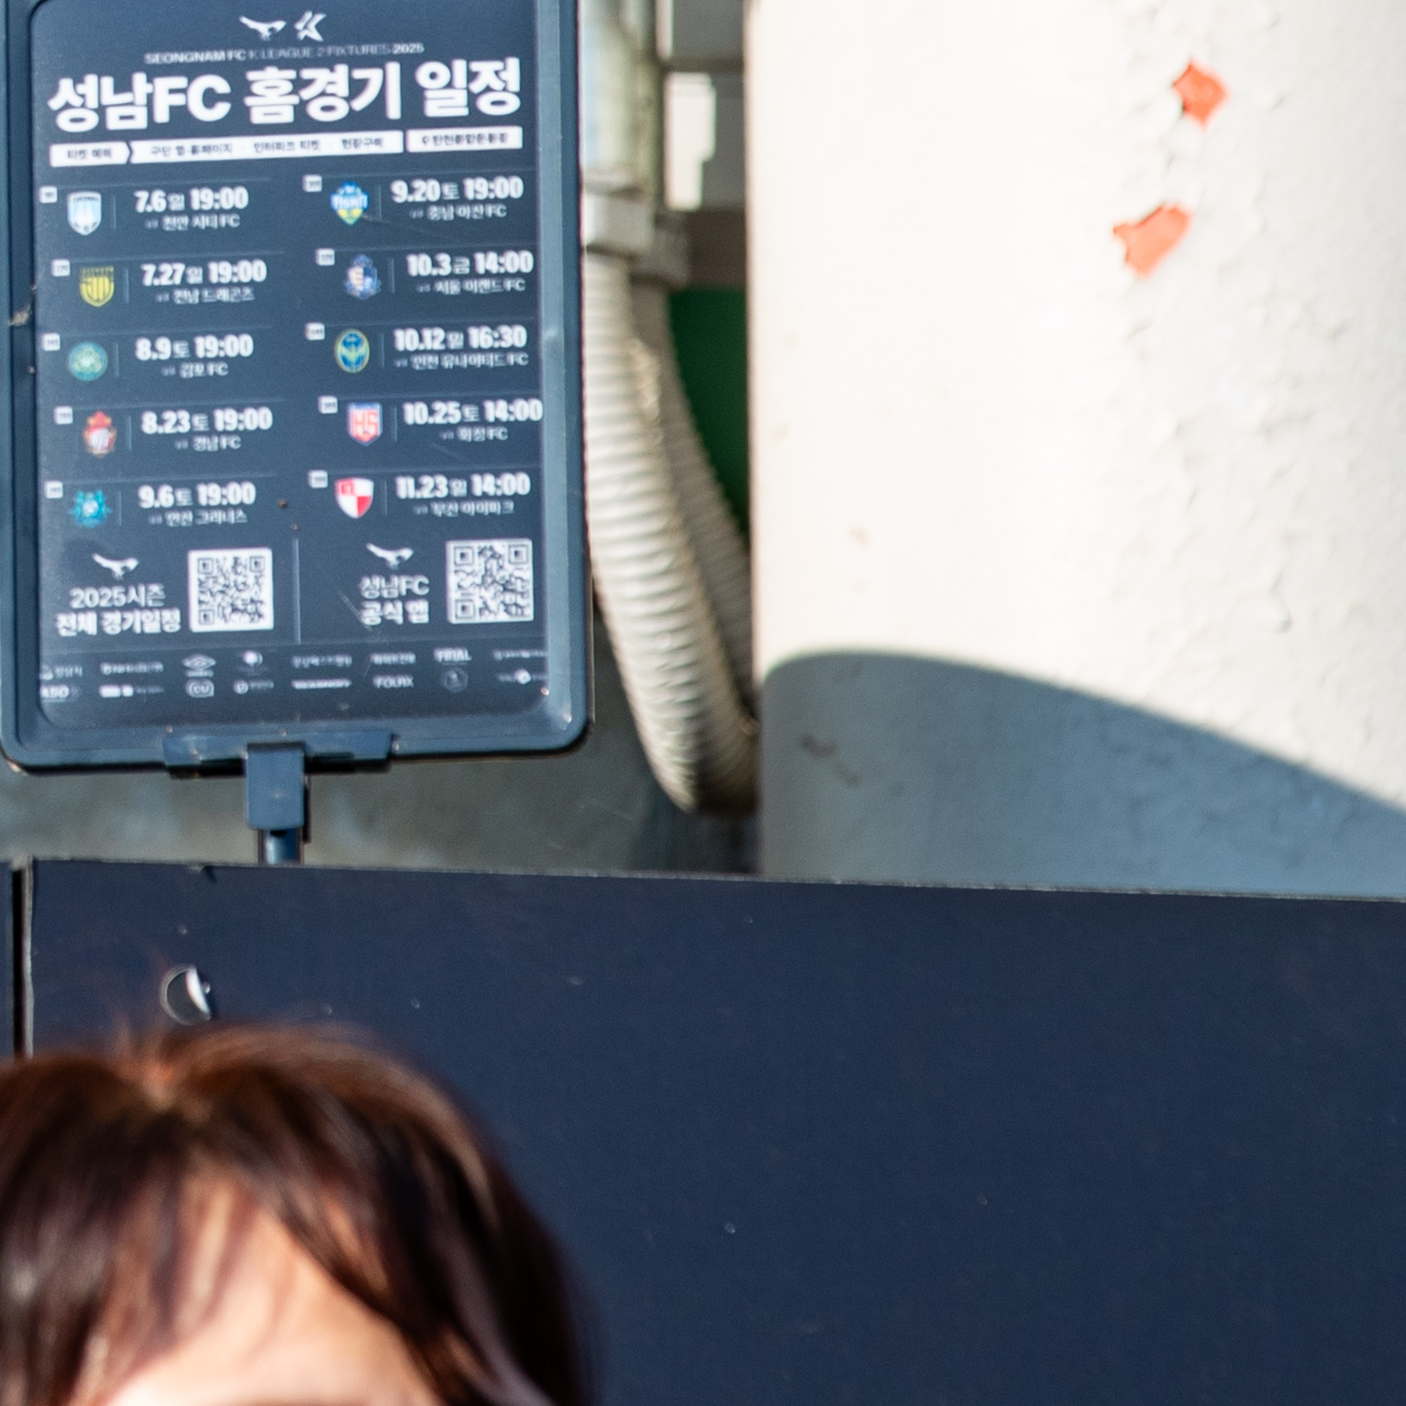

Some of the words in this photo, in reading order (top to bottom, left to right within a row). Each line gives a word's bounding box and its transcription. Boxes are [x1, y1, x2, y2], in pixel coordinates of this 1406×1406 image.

[144, 51, 226, 64] SEONGNAM
[227, 50, 246, 61] FC
[392, 43, 424, 54] 2025
[47, 71, 232, 132] 성남FC
[243, 61, 401, 124] 홈경기
[415, 56, 521, 116] 일정
[190, 186, 248, 211] 19:00
[463, 175, 524, 201] 19:00
[219, 213, 240, 228] FC
[486, 204, 507, 218] FC
[207, 259, 267, 283] 19:00
[474, 250, 534, 275] 14:00
[504, 278, 526, 292] FC
[193, 333, 254, 358] 19:00
[468, 324, 527, 349] 16:30
[208, 362, 229, 376] FC
[507, 352, 529, 366] FC
[213, 406, 273, 431] 19:00
[483, 398, 543, 422] 14:00
[220, 435, 241, 449] FC
[487, 426, 508, 440] FC
[197, 481, 256, 506] 19:00
[470, 472, 531, 496] 14:00
[70, 583, 165, 608] 2025시즌
[360, 574, 429, 599] 성남FC
[56, 610, 97, 636] 전체
[101, 608, 180, 634] 경기일정
[361, 599, 403, 625] 공식
[405, 599, 429, 624] 앱
